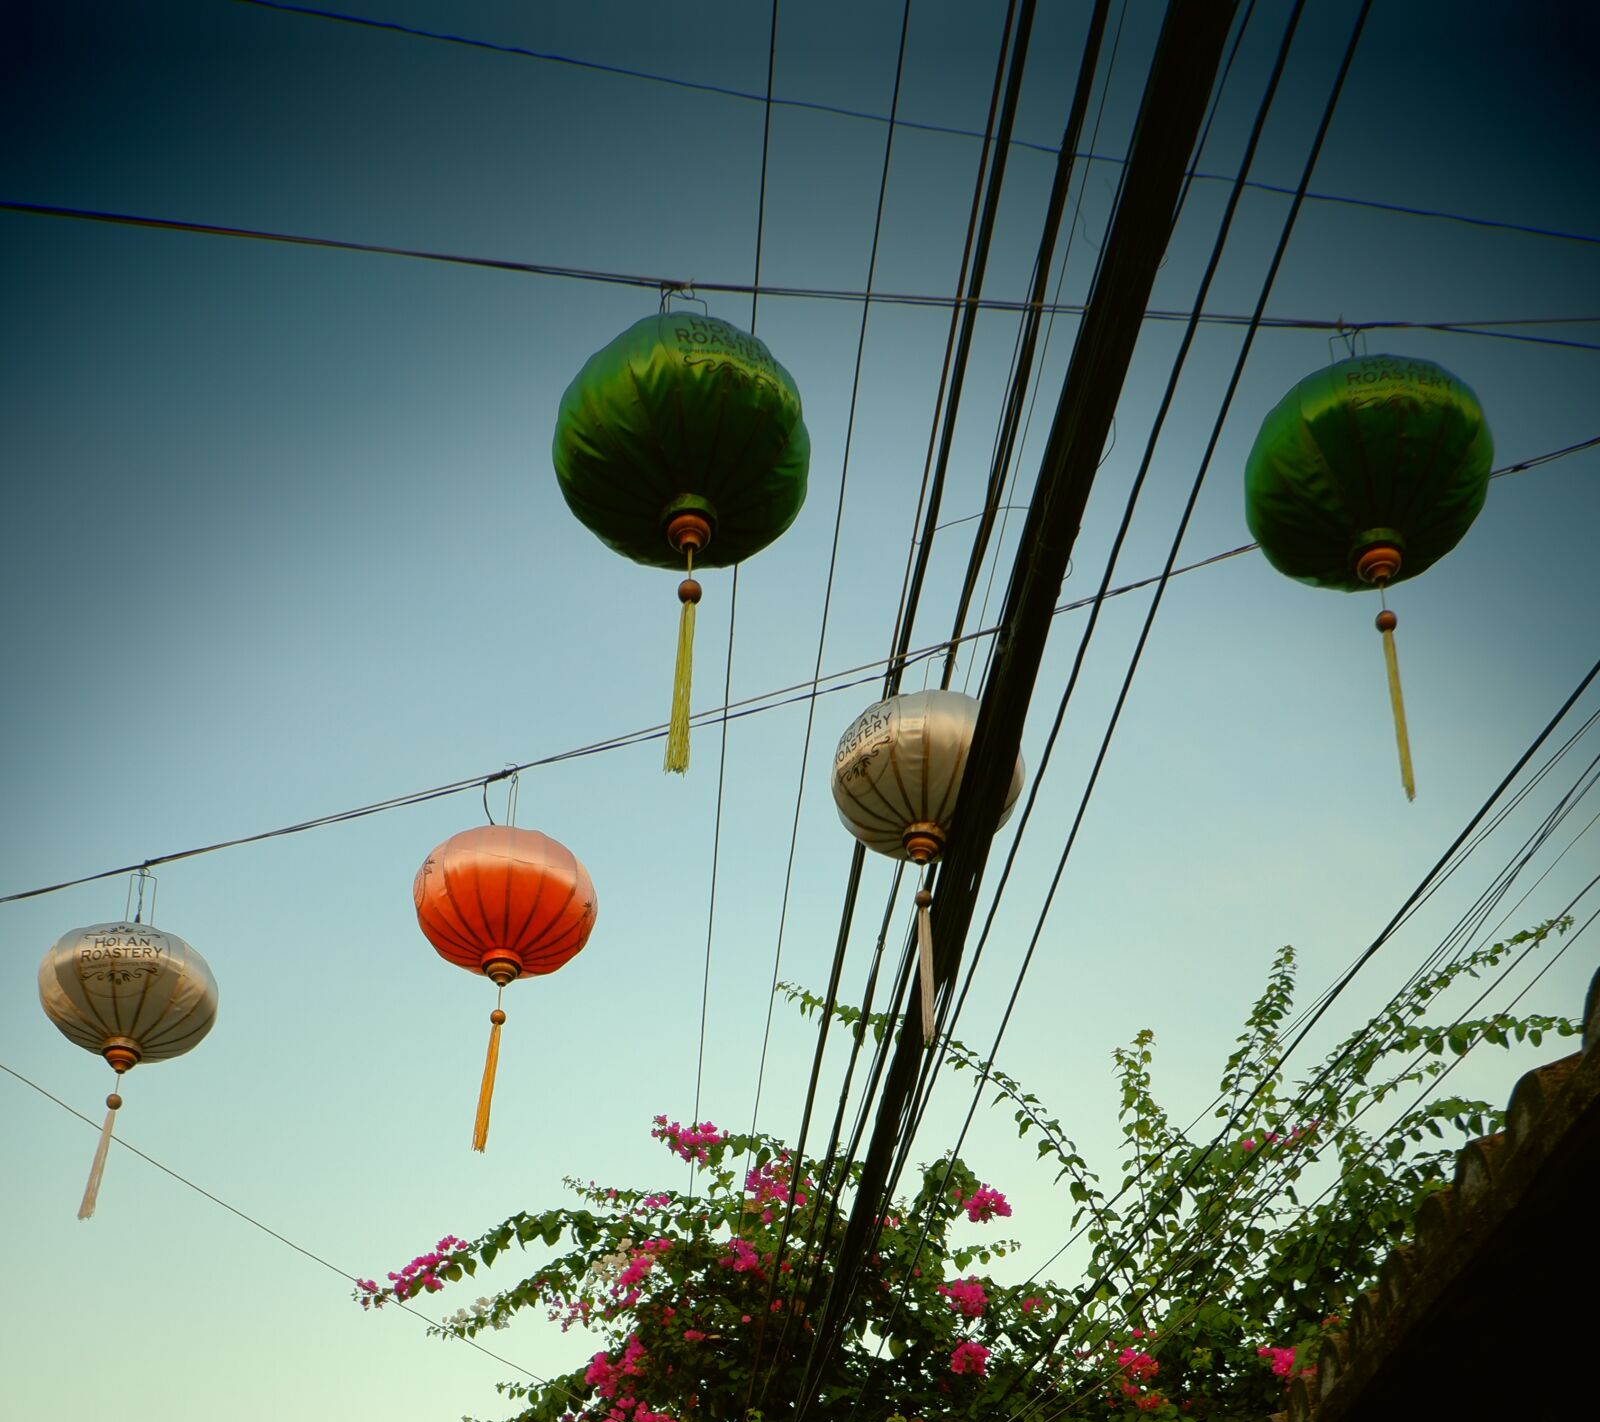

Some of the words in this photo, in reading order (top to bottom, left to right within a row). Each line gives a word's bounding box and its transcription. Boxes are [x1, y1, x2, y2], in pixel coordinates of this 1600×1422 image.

[860, 711, 881, 728] AN
[94, 936, 121, 949] HOI
[126, 936, 151, 947] AN
[80, 945, 163, 963] ROASTERY
